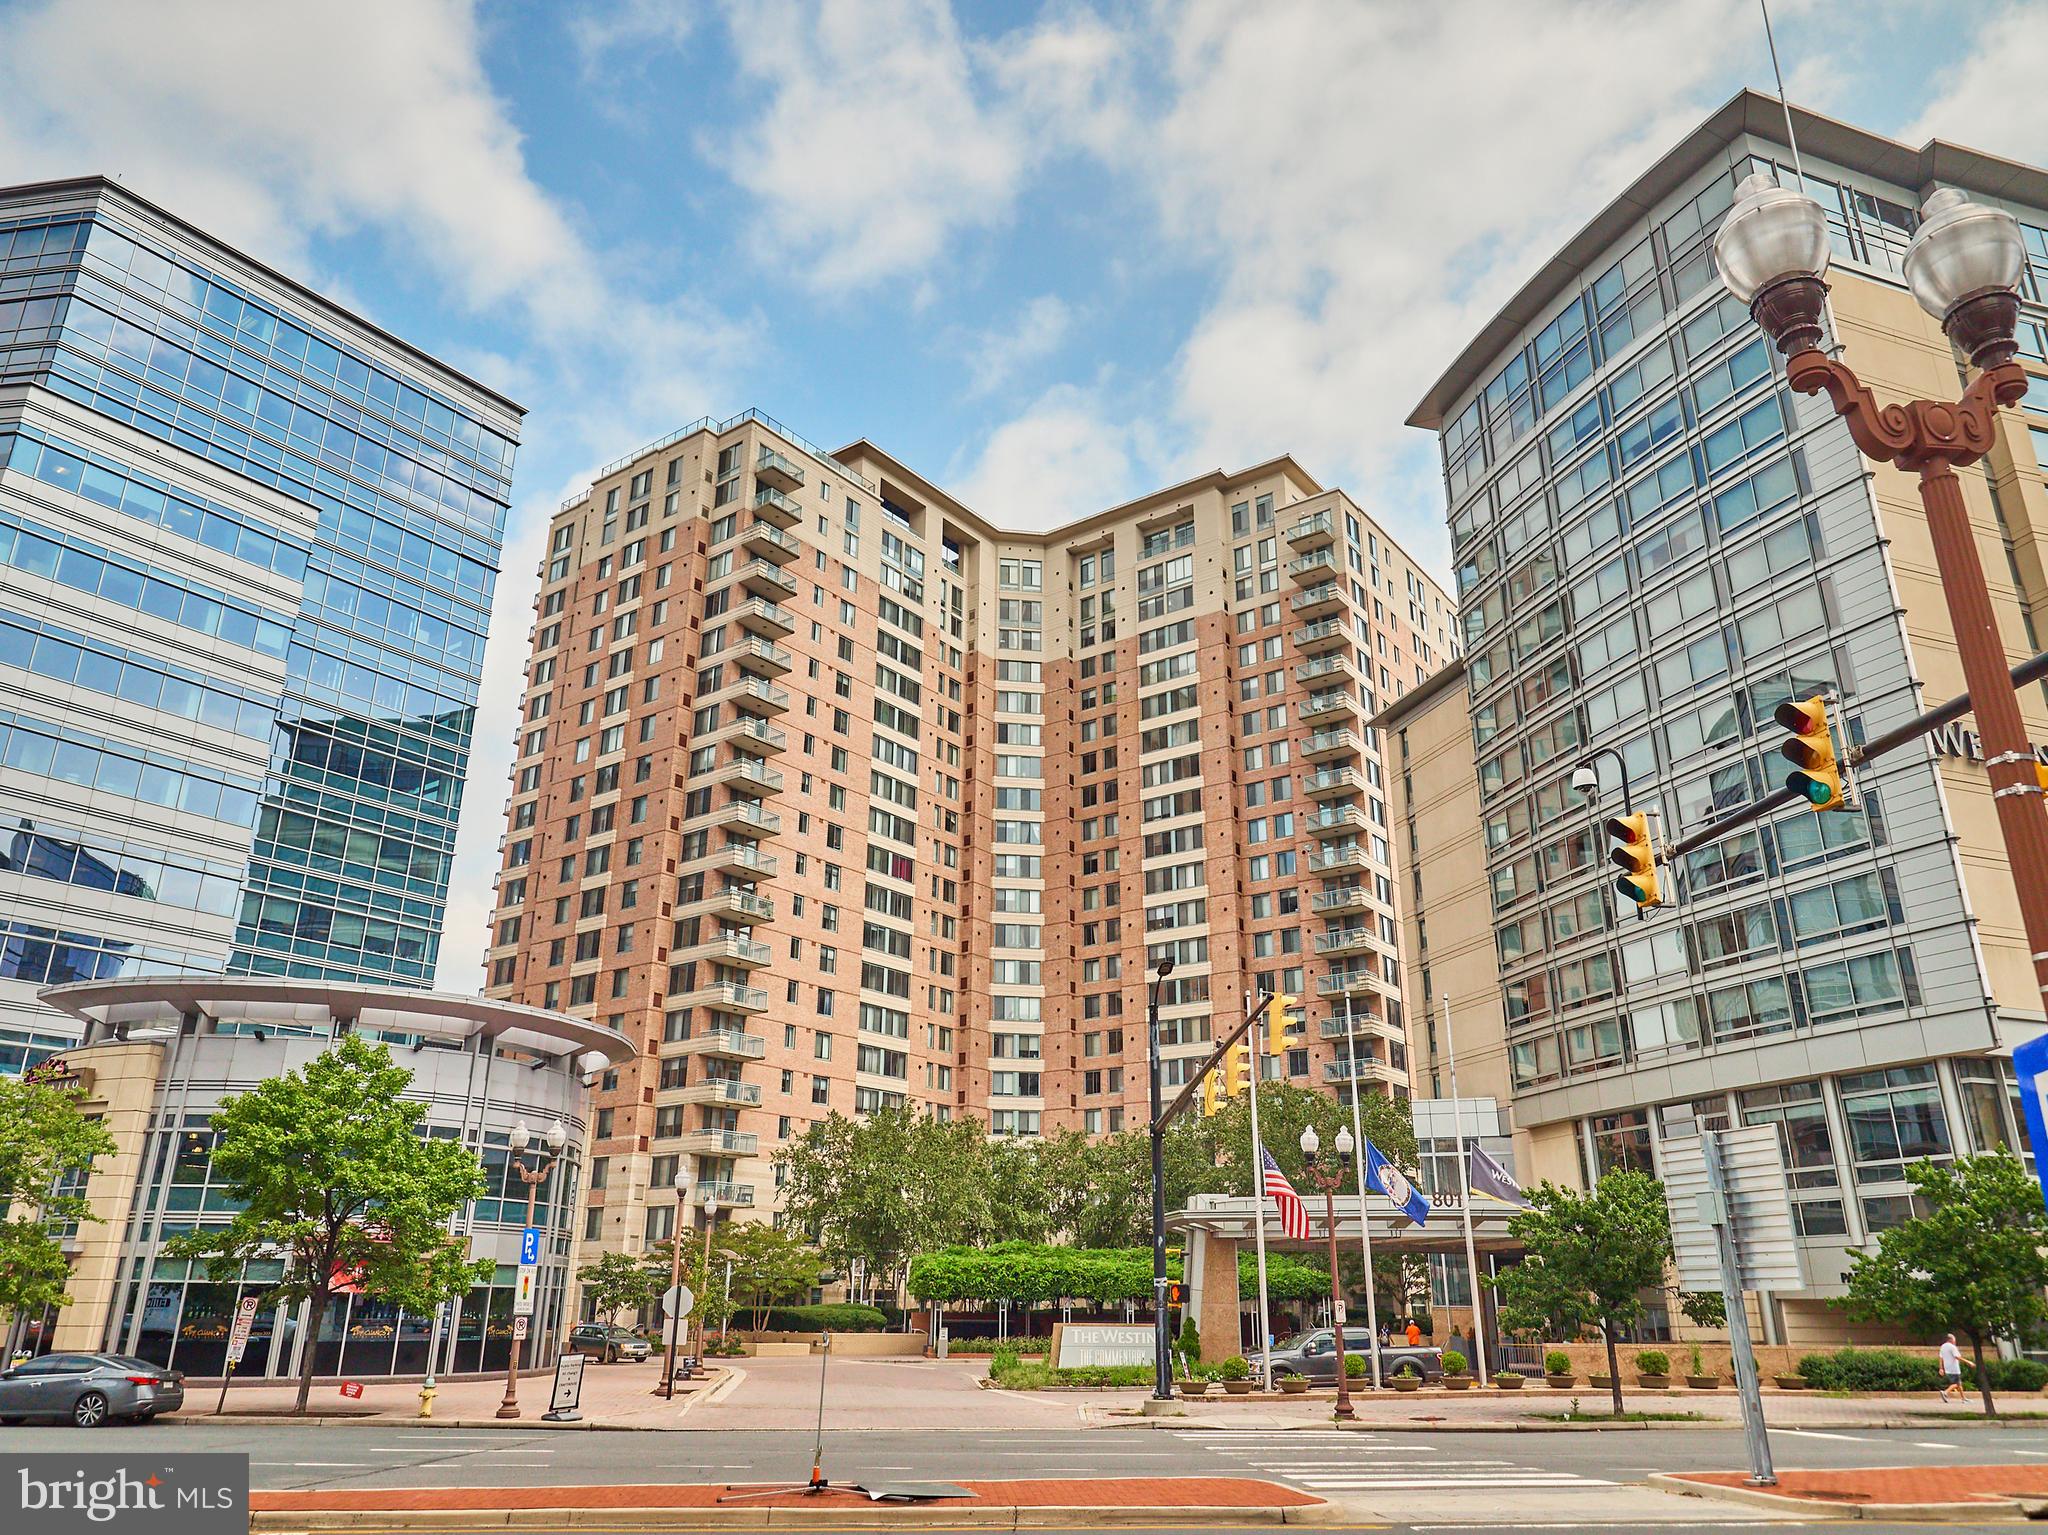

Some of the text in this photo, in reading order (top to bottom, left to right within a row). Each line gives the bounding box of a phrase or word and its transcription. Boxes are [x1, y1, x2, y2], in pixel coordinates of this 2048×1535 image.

[1432, 1191, 1462, 1207] 801
[1072, 1329, 1156, 1344] THE WESTIN
